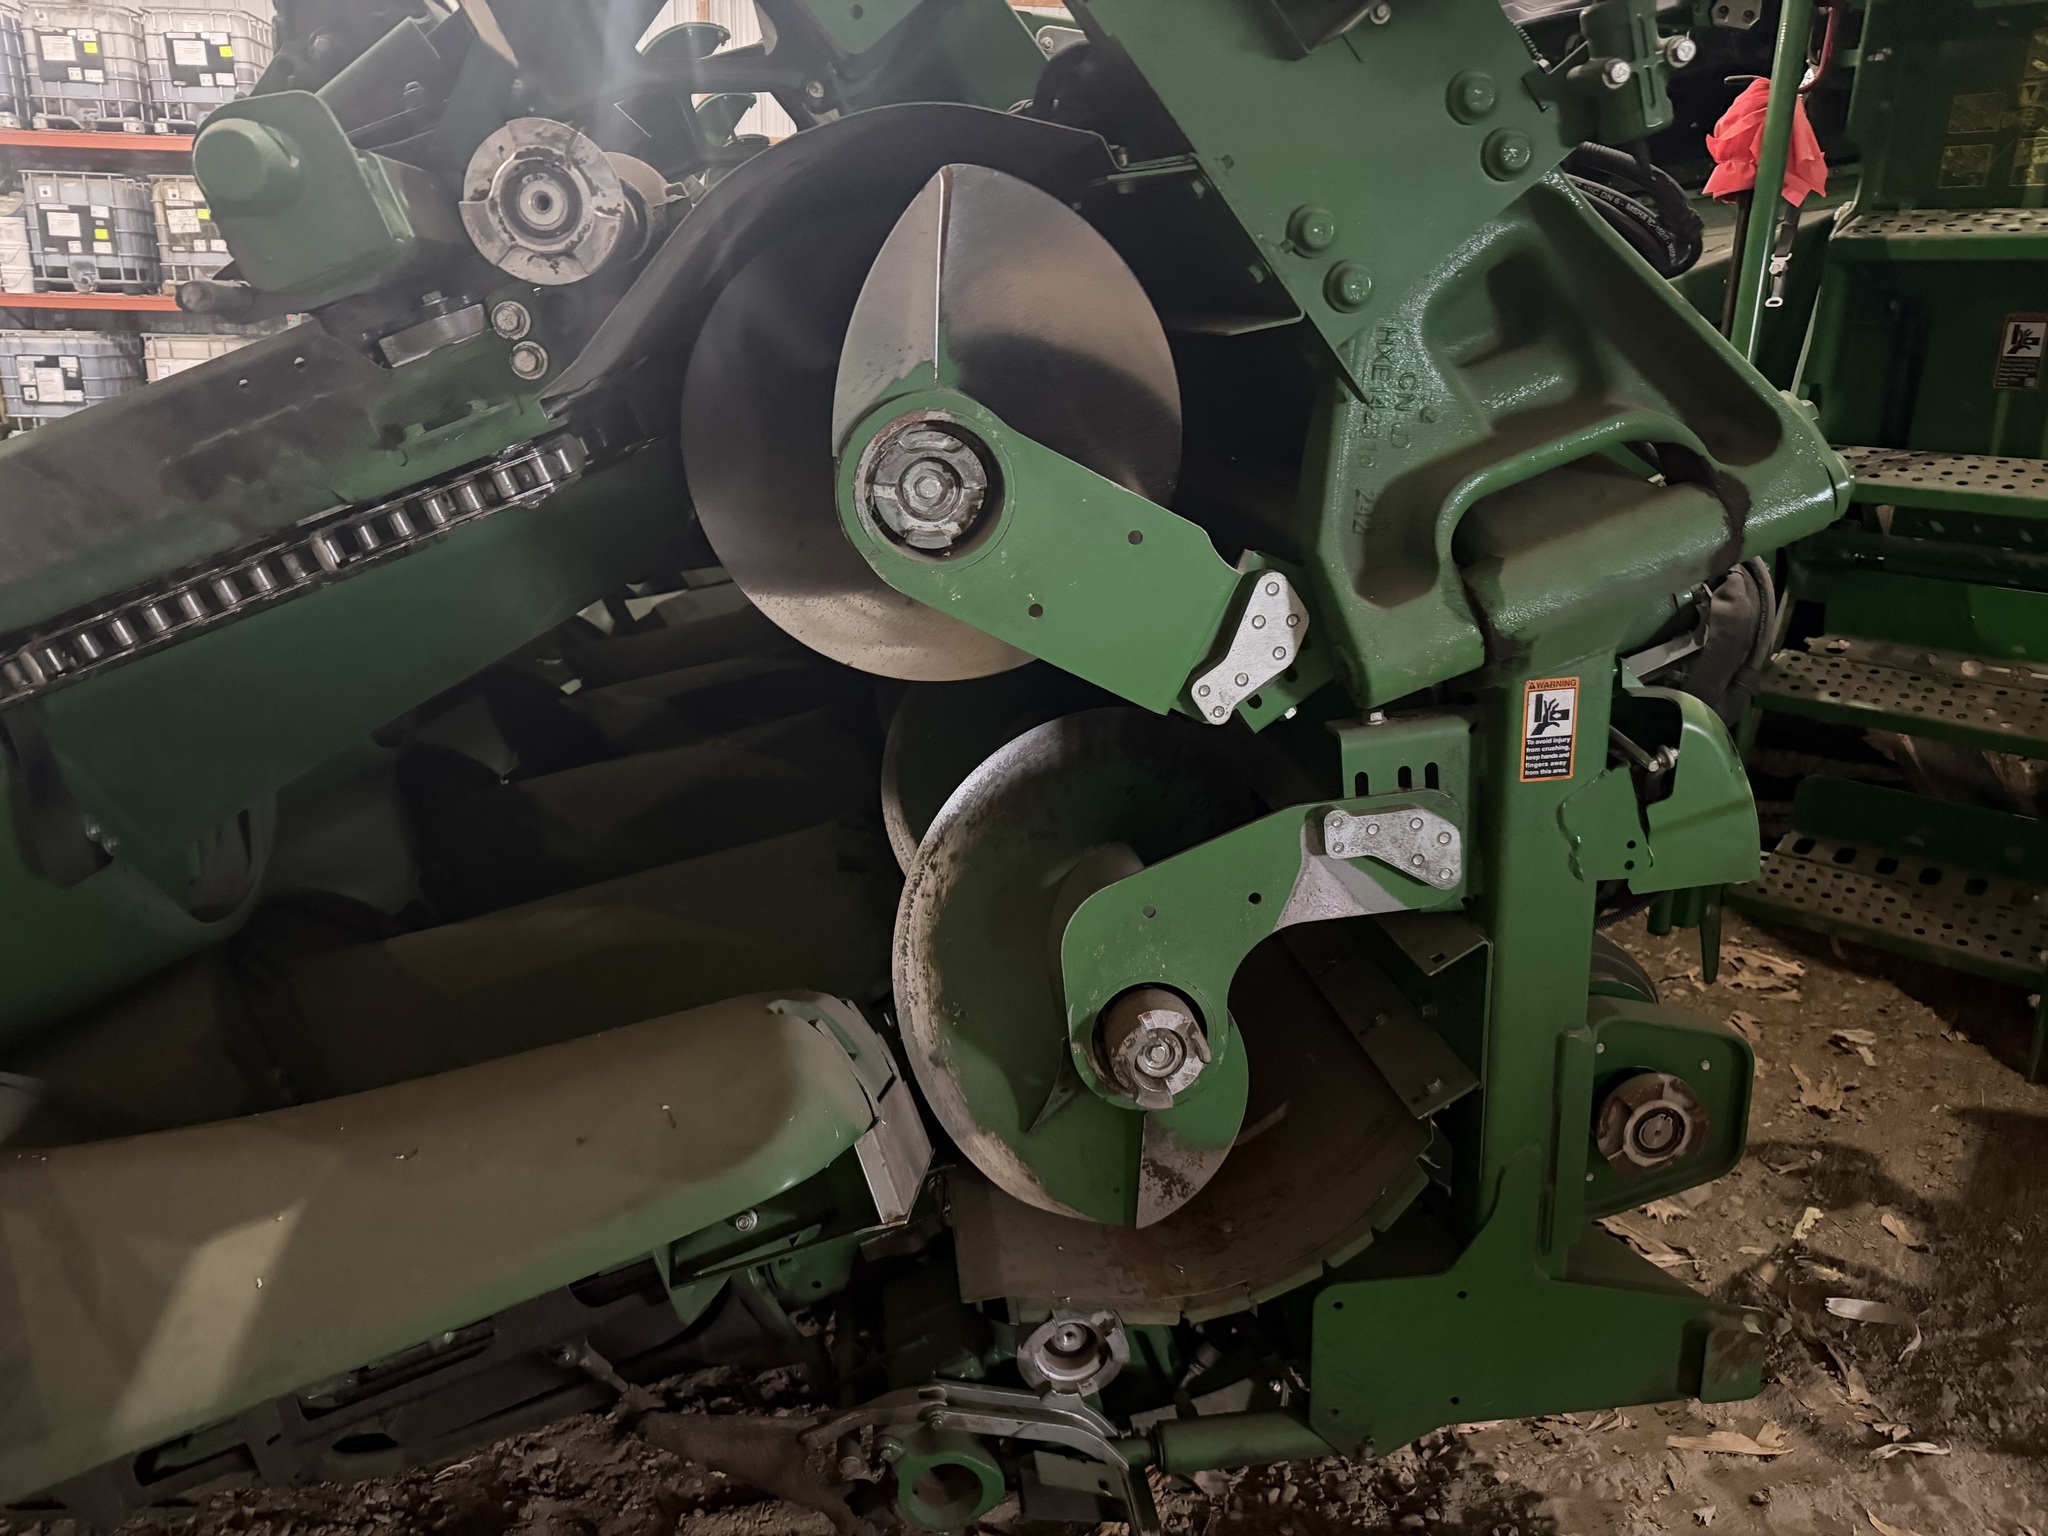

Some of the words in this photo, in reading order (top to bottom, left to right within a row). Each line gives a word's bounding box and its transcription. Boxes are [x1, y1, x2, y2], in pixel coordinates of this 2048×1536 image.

[1600, 191, 1613, 202] DN
[1613, 197, 1621, 205] 6
[1536, 679, 1577, 689] WARNING
[1552, 737, 1571, 745] injury
[1541, 745, 1571, 753] crushing,
[1525, 754, 1541, 762] keep
[1525, 761, 1549, 769] fingers
